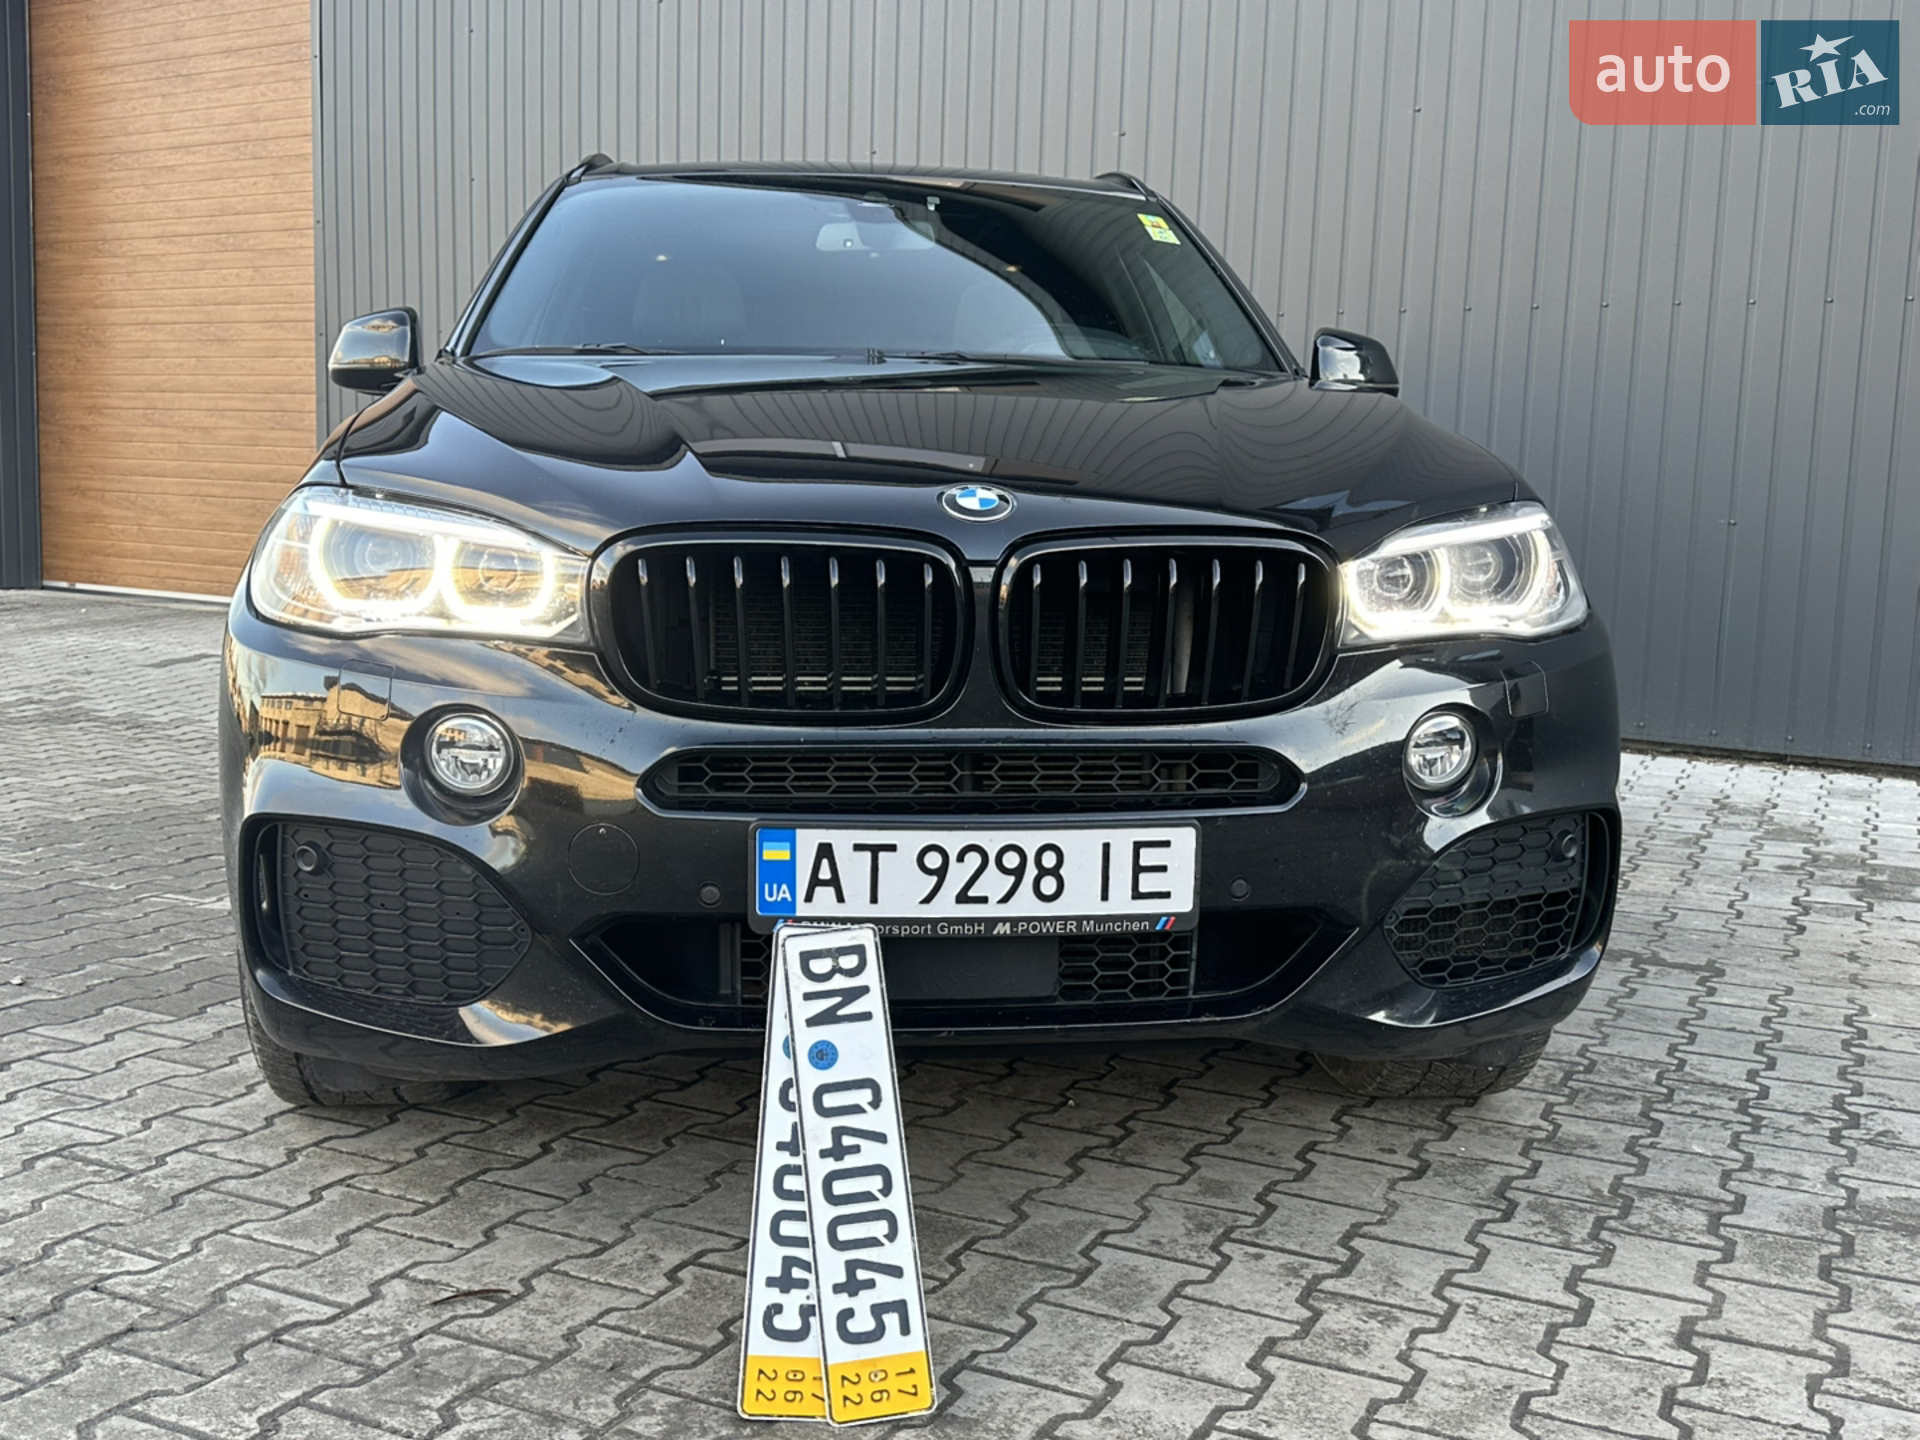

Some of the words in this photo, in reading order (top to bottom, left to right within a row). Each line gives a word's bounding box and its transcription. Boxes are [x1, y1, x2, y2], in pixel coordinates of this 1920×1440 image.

[803, 841, 898, 905] AT
[915, 842, 1065, 905] 9298
[1099, 839, 1172, 902] IE
[764, 883, 792, 902] UA
[937, 921, 985, 935] GmbH
[798, 943, 874, 1028] BN
[812, 1077, 911, 1345] 040045
[756, 1368, 778, 1402] 22
[784, 1369, 805, 1403] 06
[841, 1373, 863, 1408] 22
[868, 1369, 890, 1403] 06
[895, 1367, 918, 1398] 17
